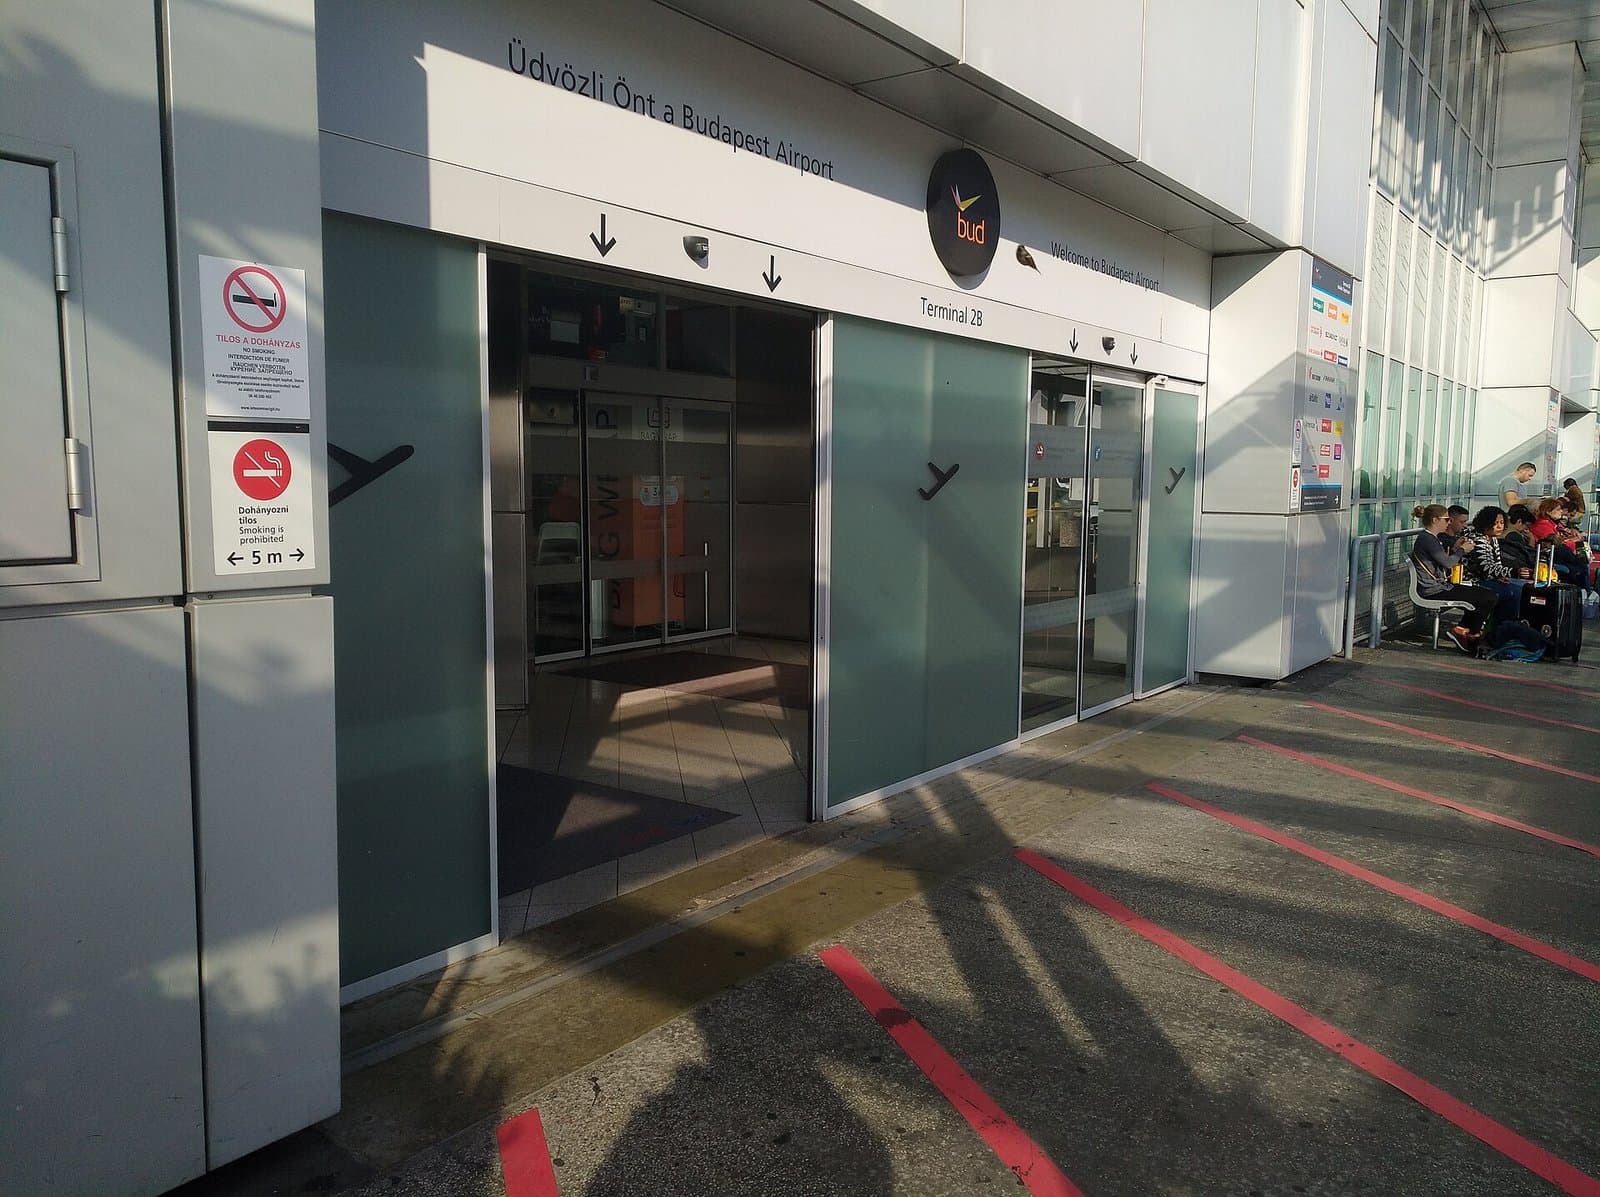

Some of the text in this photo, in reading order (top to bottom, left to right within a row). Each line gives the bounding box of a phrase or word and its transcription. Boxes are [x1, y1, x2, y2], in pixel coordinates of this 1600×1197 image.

[508, 37, 834, 181] Üdvözli Önt a Budapest Airport
[957, 211, 985, 245] bud
[1051, 240, 1160, 292] Welcome to Budapest Airport
[920, 296, 983, 327] Terminal 2B
[216, 334, 301, 349] TILOS A DOHÁNYZÁS
[228, 353, 264, 362] INTERDICTION
[238, 505, 289, 515] Dohányozni
[239, 516, 257, 525] tilos
[239, 525, 284, 535] Smoking is
[240, 535, 284, 546] prohibited
[252, 550, 282, 565] 5 m
